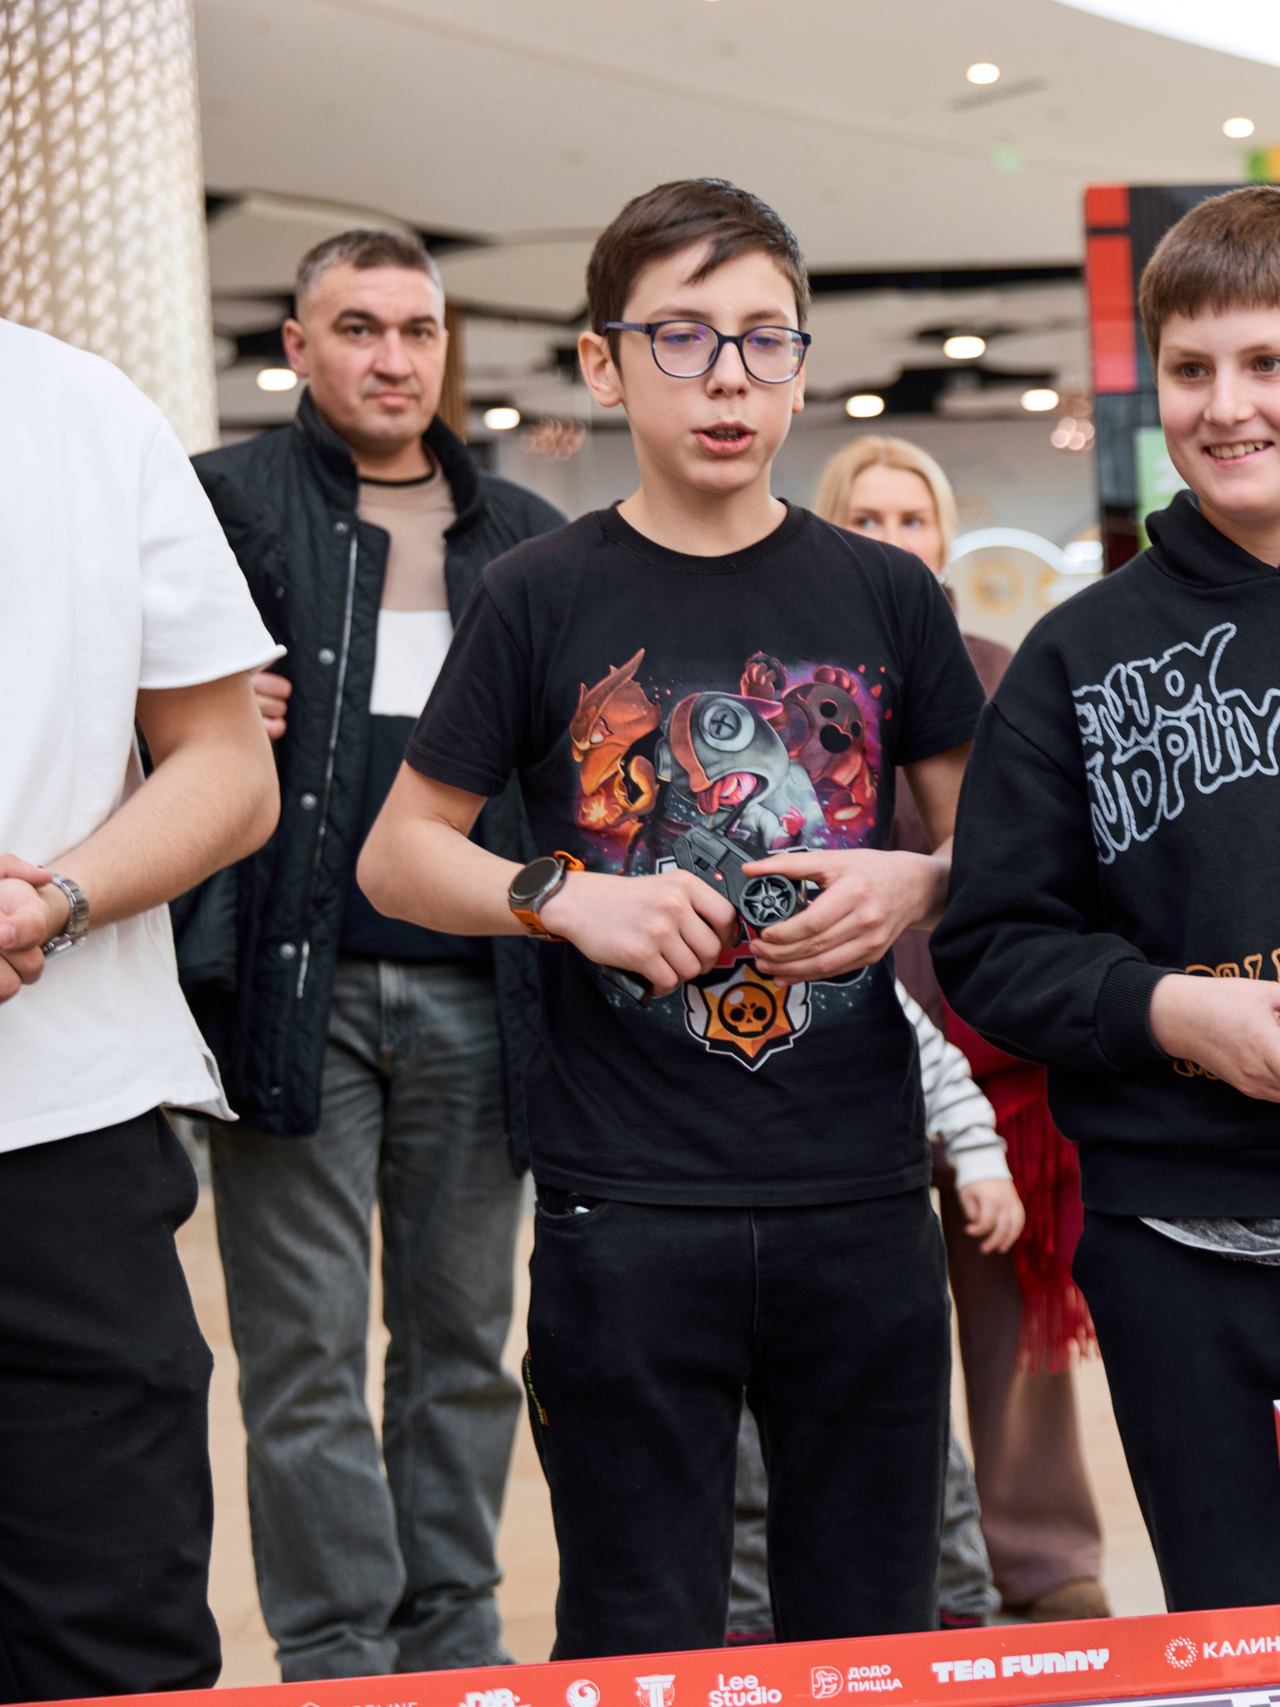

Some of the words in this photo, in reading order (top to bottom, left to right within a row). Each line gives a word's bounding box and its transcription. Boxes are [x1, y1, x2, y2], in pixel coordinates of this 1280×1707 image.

[848, 1664, 892, 1681] ДОДО
[931, 1657, 996, 1683] TEA
[1001, 1648, 1110, 1678] FUNNY
[718, 1673, 759, 1691] Lee
[848, 1676, 903, 1692] ПИЦЦА
[708, 1686, 783, 1707] Studio
